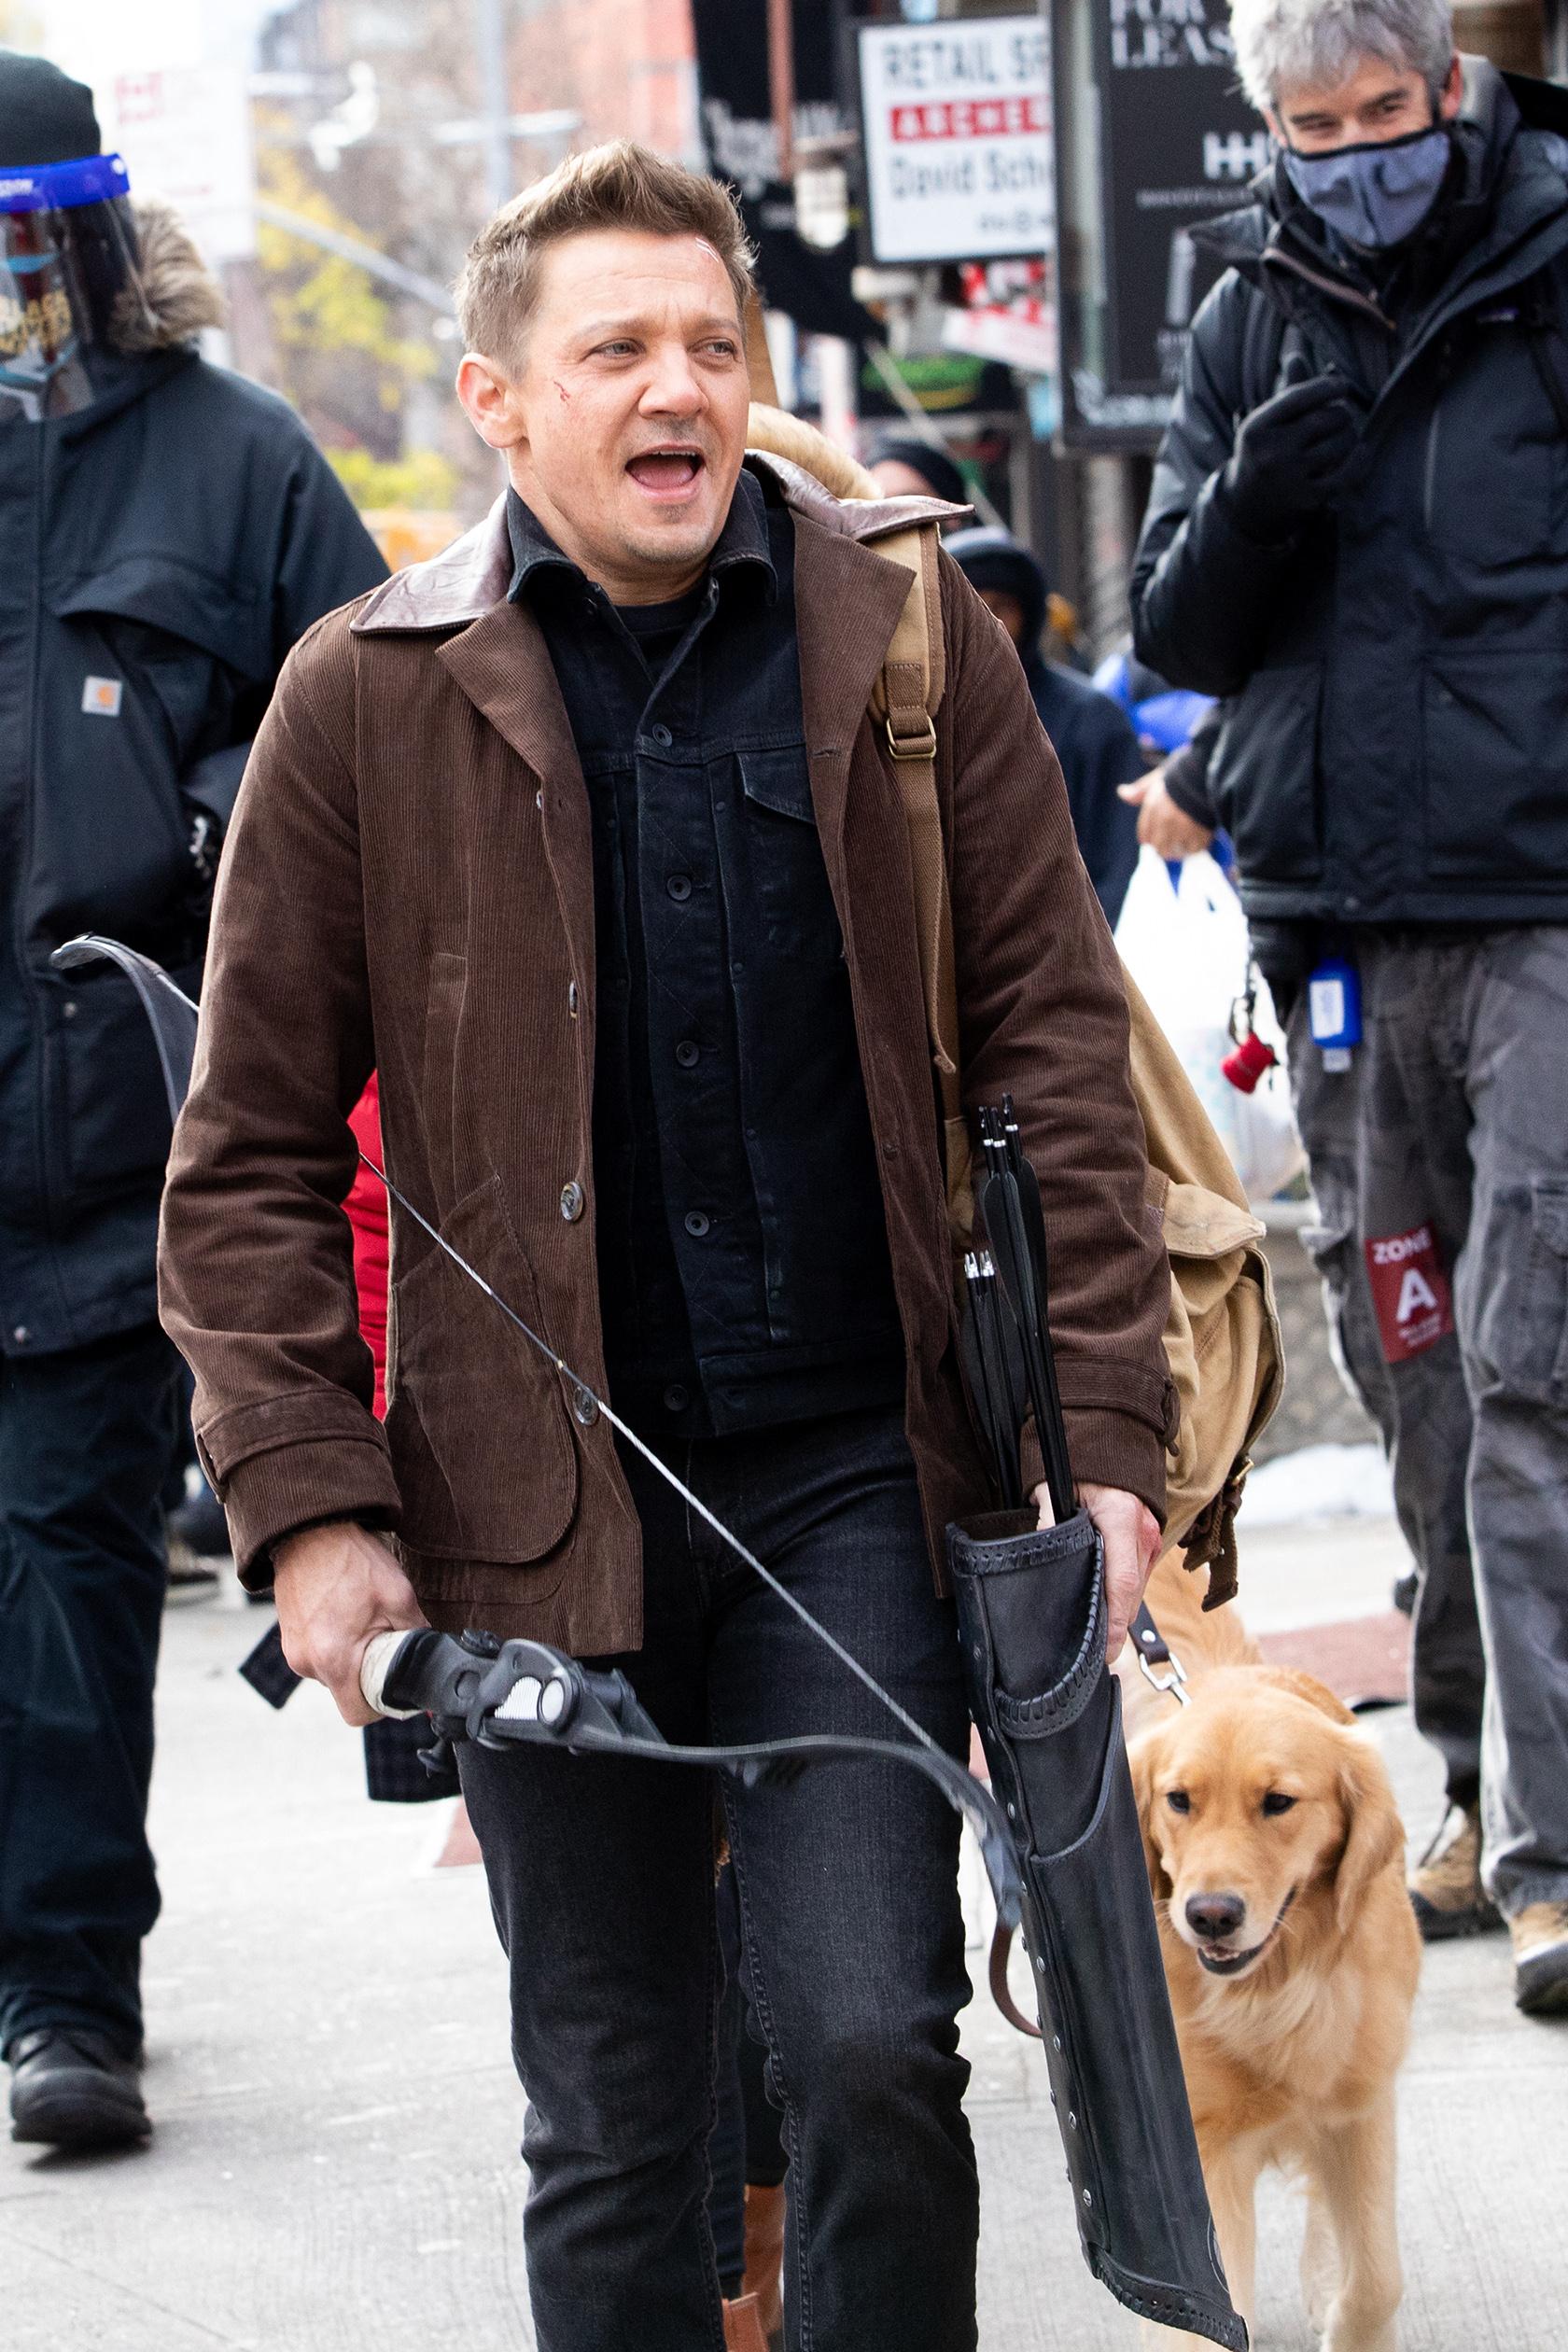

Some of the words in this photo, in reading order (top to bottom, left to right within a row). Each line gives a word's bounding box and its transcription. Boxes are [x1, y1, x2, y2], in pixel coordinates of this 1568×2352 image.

[885, 39, 997, 87] RETAIL
[890, 152, 974, 198] David
[1395, 1267, 1438, 1323] A
